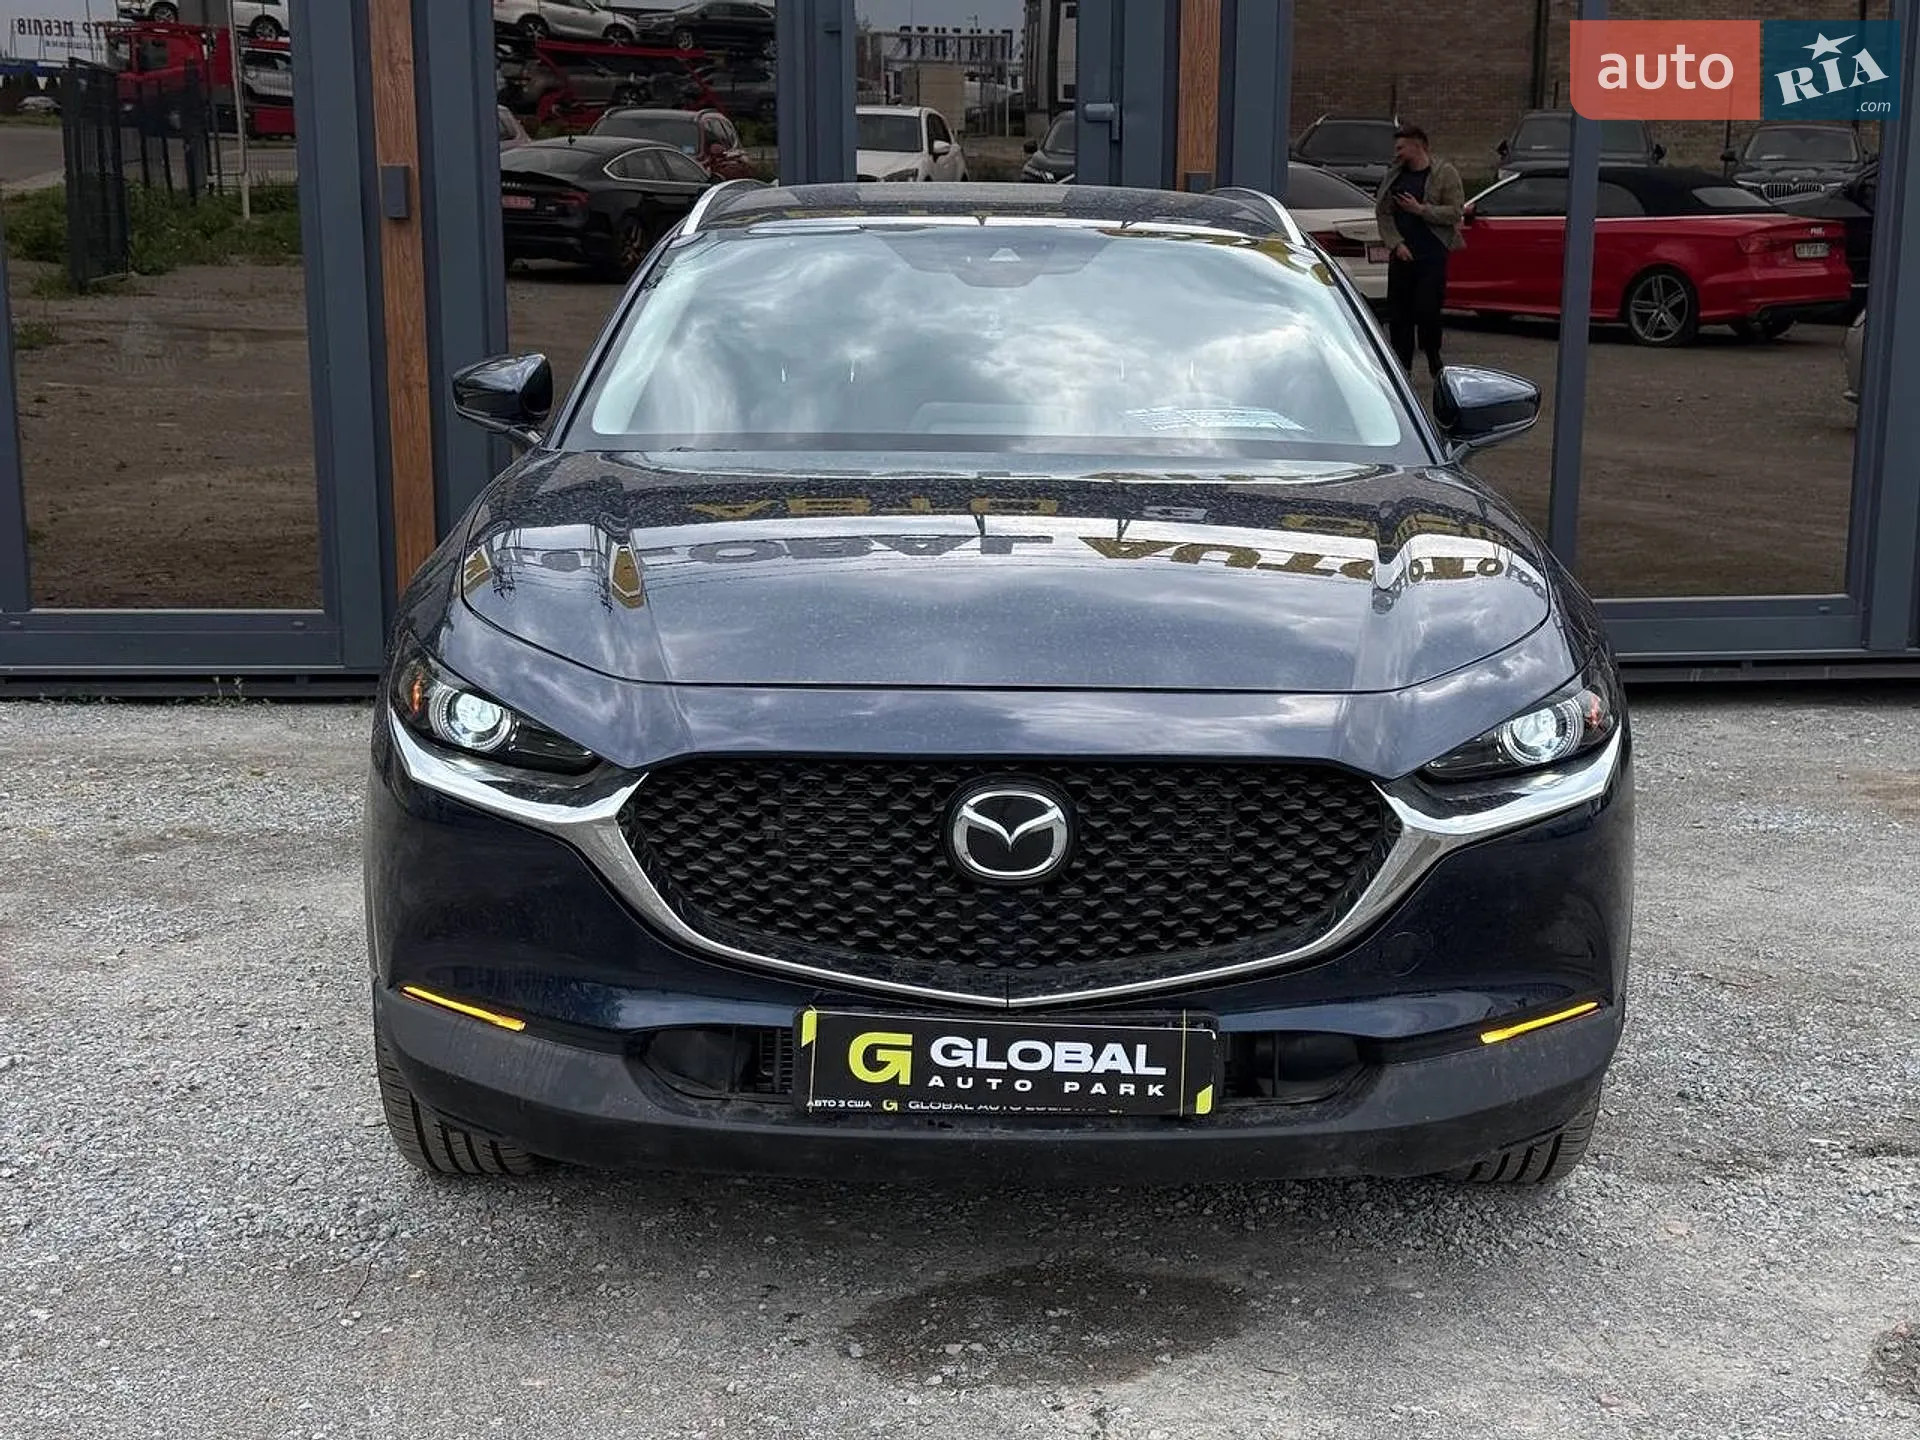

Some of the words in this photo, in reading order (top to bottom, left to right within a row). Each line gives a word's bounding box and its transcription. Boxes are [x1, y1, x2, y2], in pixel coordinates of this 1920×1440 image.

[930, 1036, 1167, 1076] GLOBAL
[928, 1075, 1033, 1092] AUTO
[1063, 1081, 1165, 1097] PARK
